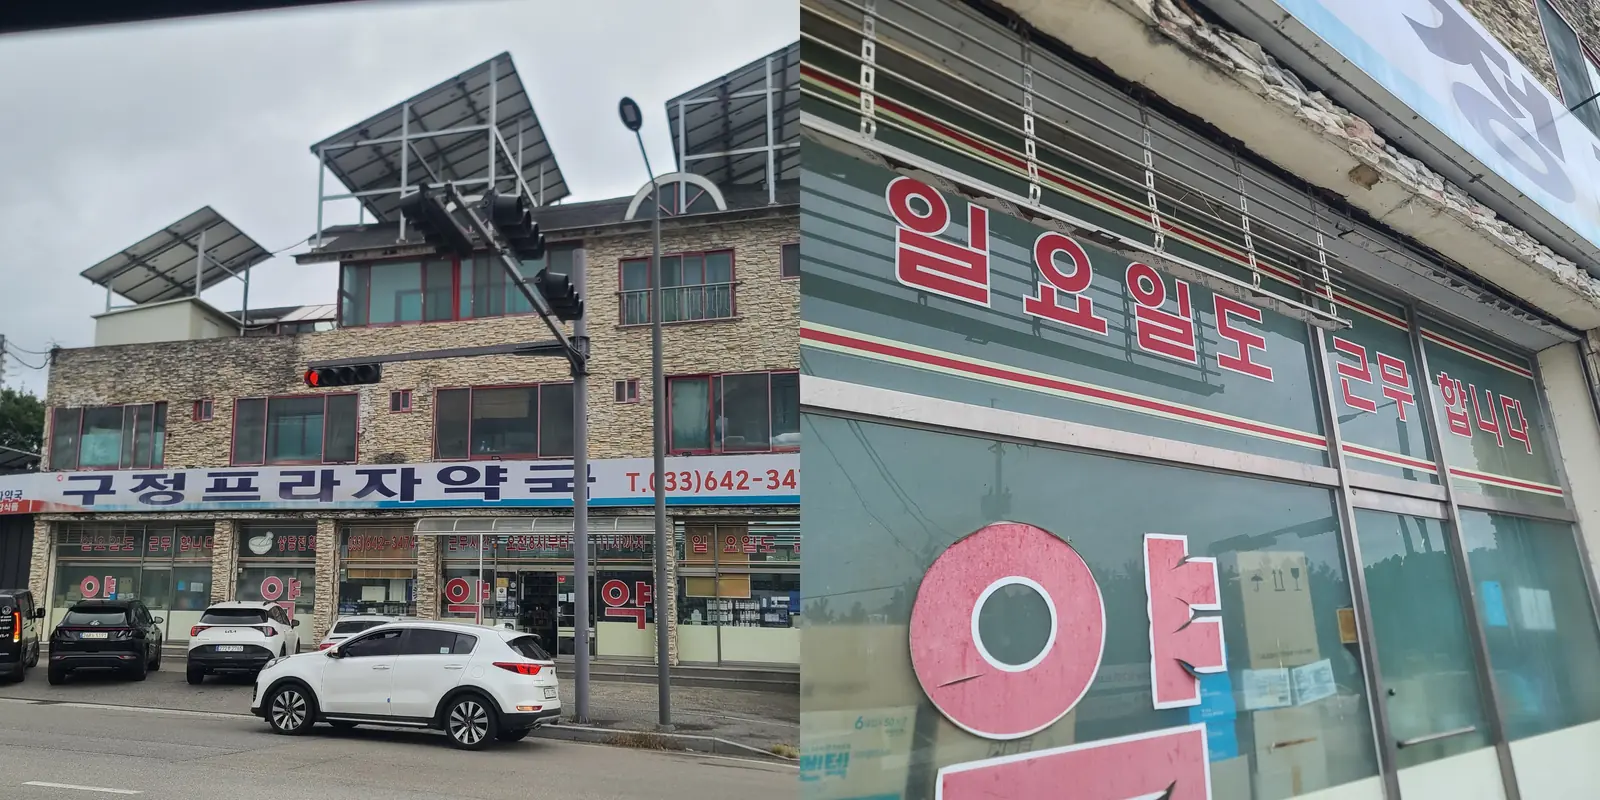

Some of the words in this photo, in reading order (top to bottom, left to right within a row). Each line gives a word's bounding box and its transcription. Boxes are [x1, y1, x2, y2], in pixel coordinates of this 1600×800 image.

[885, 175, 1274, 382] 일요일도
[1332, 335, 1415, 423] 근무
[1436, 370, 1533, 455] 합니다
[63, 464, 597, 506] 구정프라자약국
[626, 469, 800, 494] T.33)642-34
[148, 536, 172, 552] 근무
[445, 577, 491, 626] 약
[601, 579, 652, 631] 약
[909, 520, 1228, 800] 약
